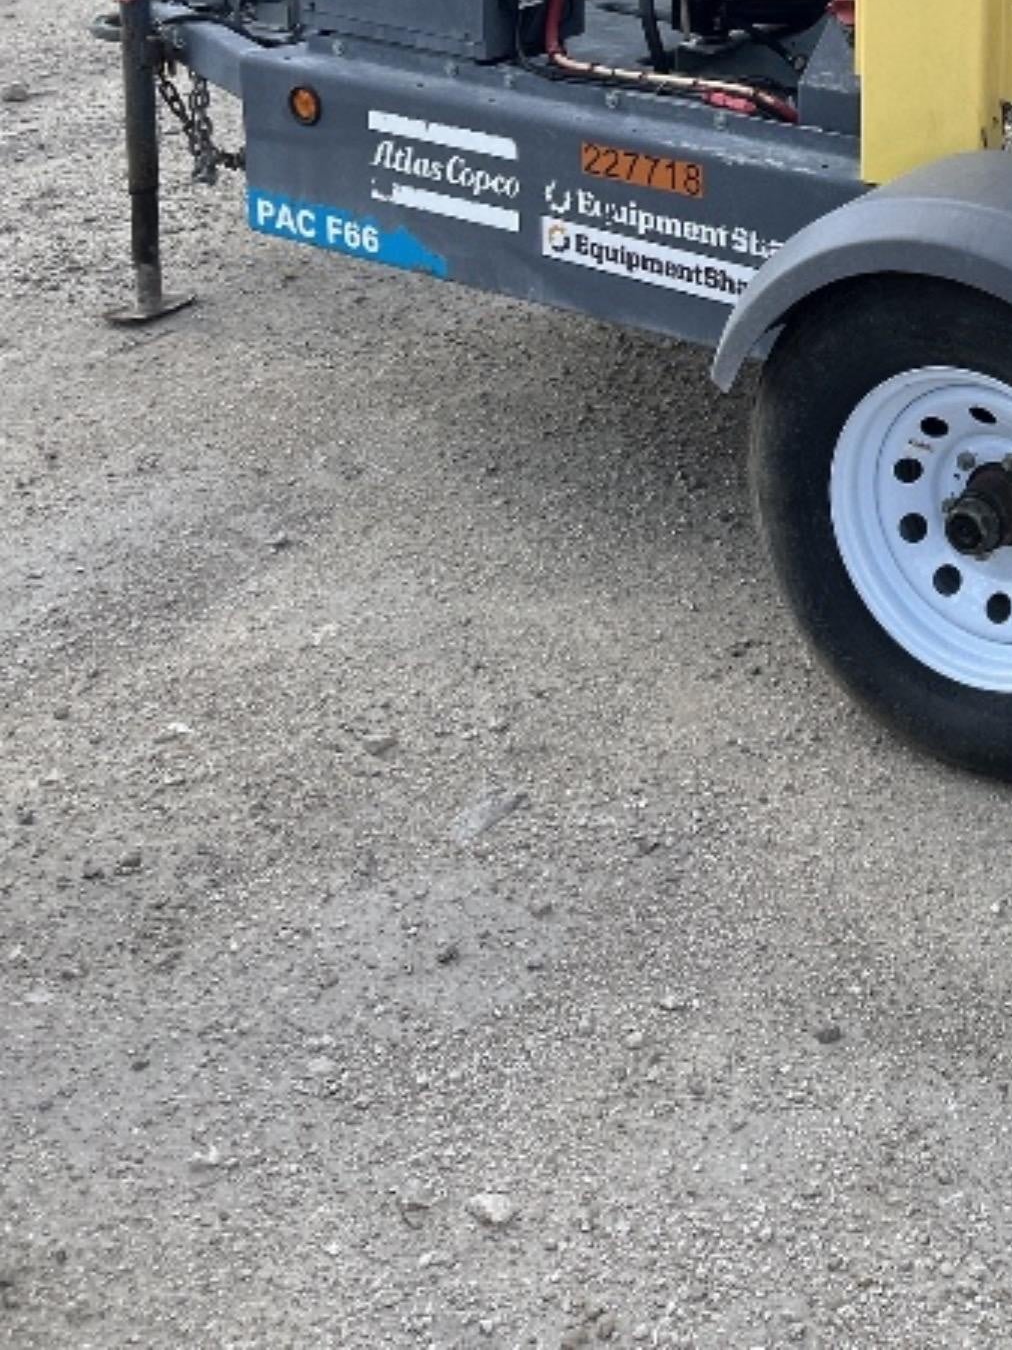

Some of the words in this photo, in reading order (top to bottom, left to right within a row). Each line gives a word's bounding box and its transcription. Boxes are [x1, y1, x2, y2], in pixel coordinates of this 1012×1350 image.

[369, 140, 445, 182] Atlas
[445, 154, 520, 198] Copco
[583, 142, 701, 196] 227718
[256, 198, 317, 239] PAC
[326, 215, 380, 254] F66
